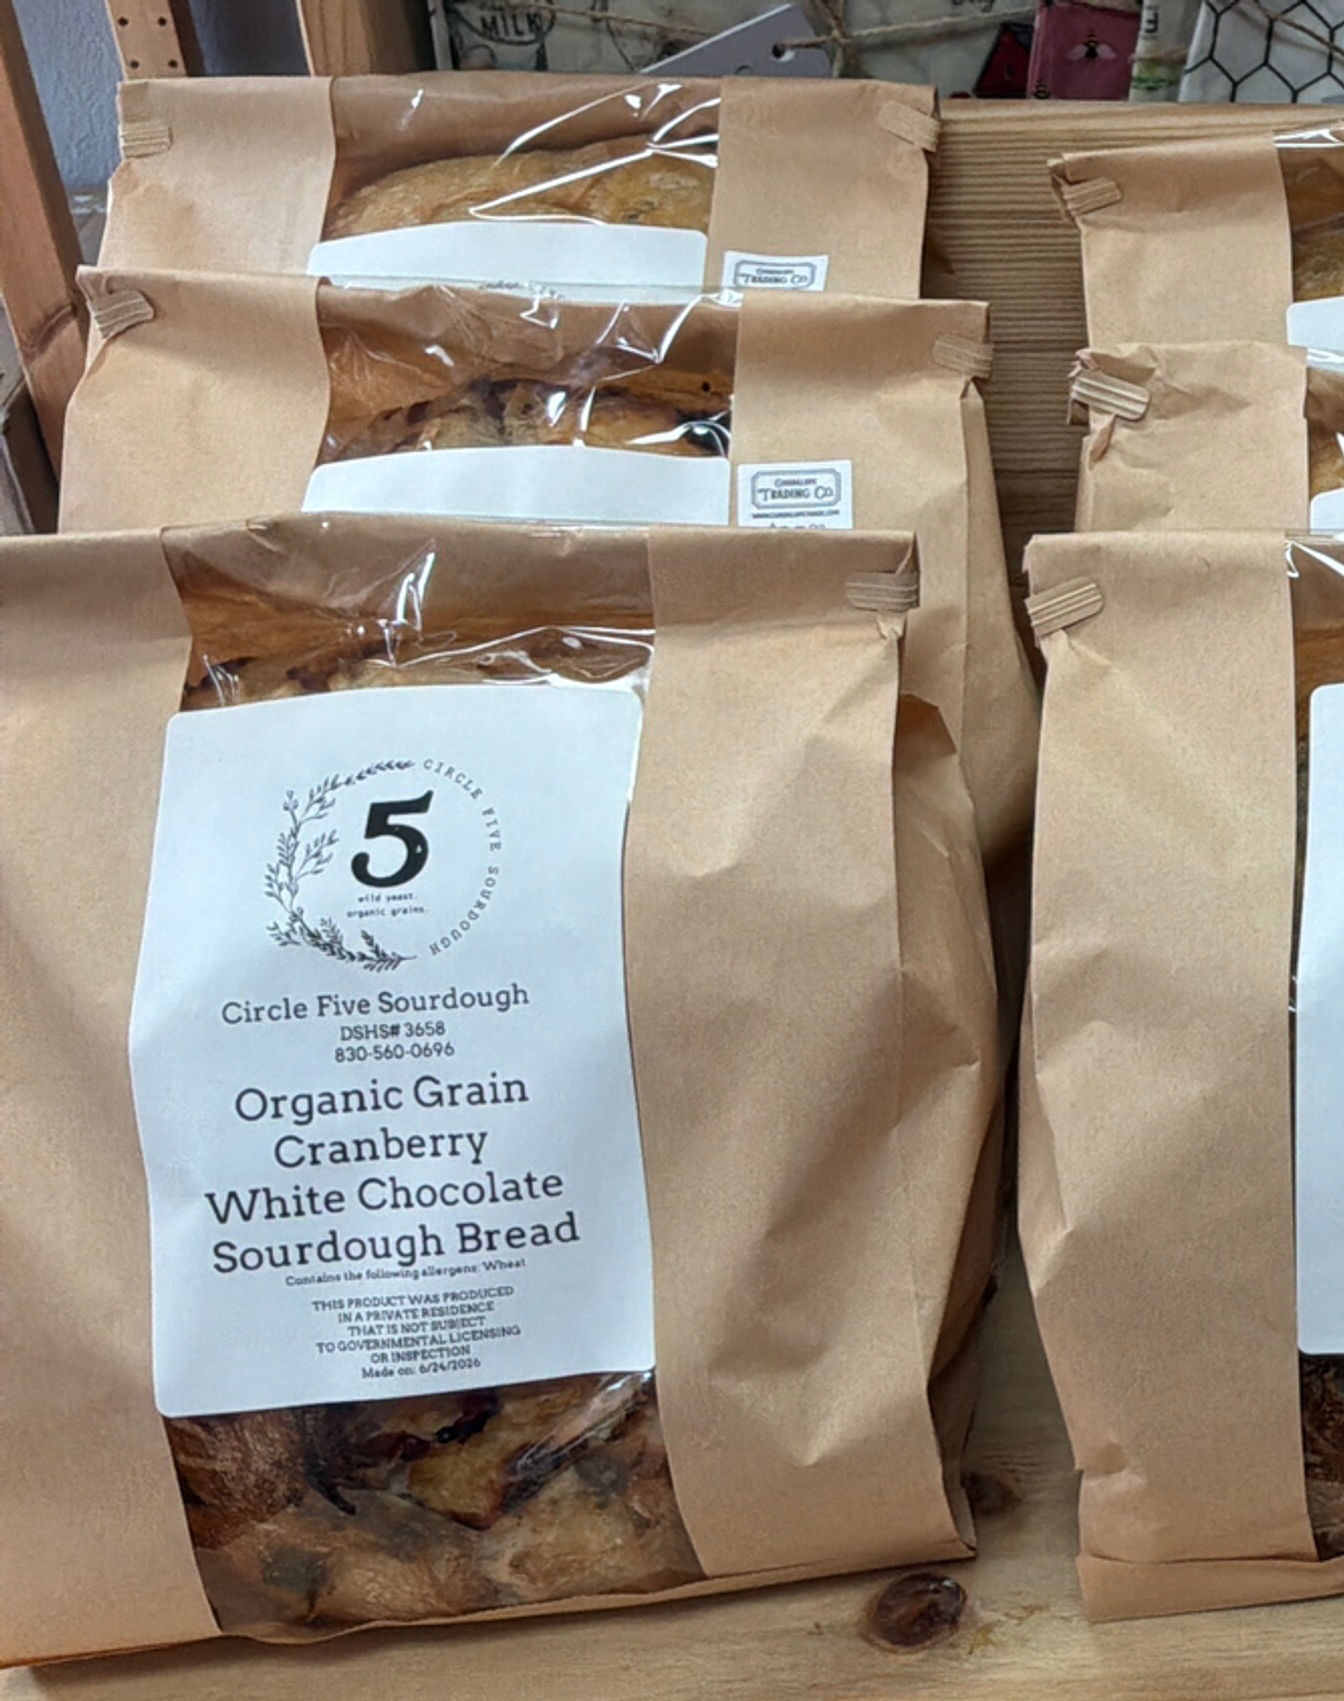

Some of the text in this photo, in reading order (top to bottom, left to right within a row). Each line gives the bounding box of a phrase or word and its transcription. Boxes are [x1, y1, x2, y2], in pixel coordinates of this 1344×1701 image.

[351, 790, 433, 888] 5
[423, 758, 502, 955] CIRCLE FIVE SOURDOUGH
[221, 983, 530, 1024] Circle Five Sourdough
[341, 1021, 446, 1041] DSHS# 3658
[335, 1041, 454, 1063] 830-560-0696
[235, 1072, 529, 1126] Organic Grain
[274, 1128, 488, 1168] Cranberry
[205, 1171, 564, 1224] White Chocolate
[212, 1211, 581, 1274] Sourdough Bread
[285, 1273, 340, 1286] Contains
[344, 1272, 363, 1282] the
[366, 1268, 420, 1280] following
[482, 1259, 526, 1271] Wheat
[312, 1286, 515, 1312] THIS PRODUCT WAS PRODUCED
[338, 1301, 495, 1323] IN A PRIVATE RESIDENCE
[316, 1325, 521, 1354] TO GOVERNMENTAL LICENSING
[348, 1316, 487, 1337] THAT IS NOT SUBJECT
[370, 1345, 471, 1364] OR INSPECTION
[362, 1367, 395, 1378] Made
